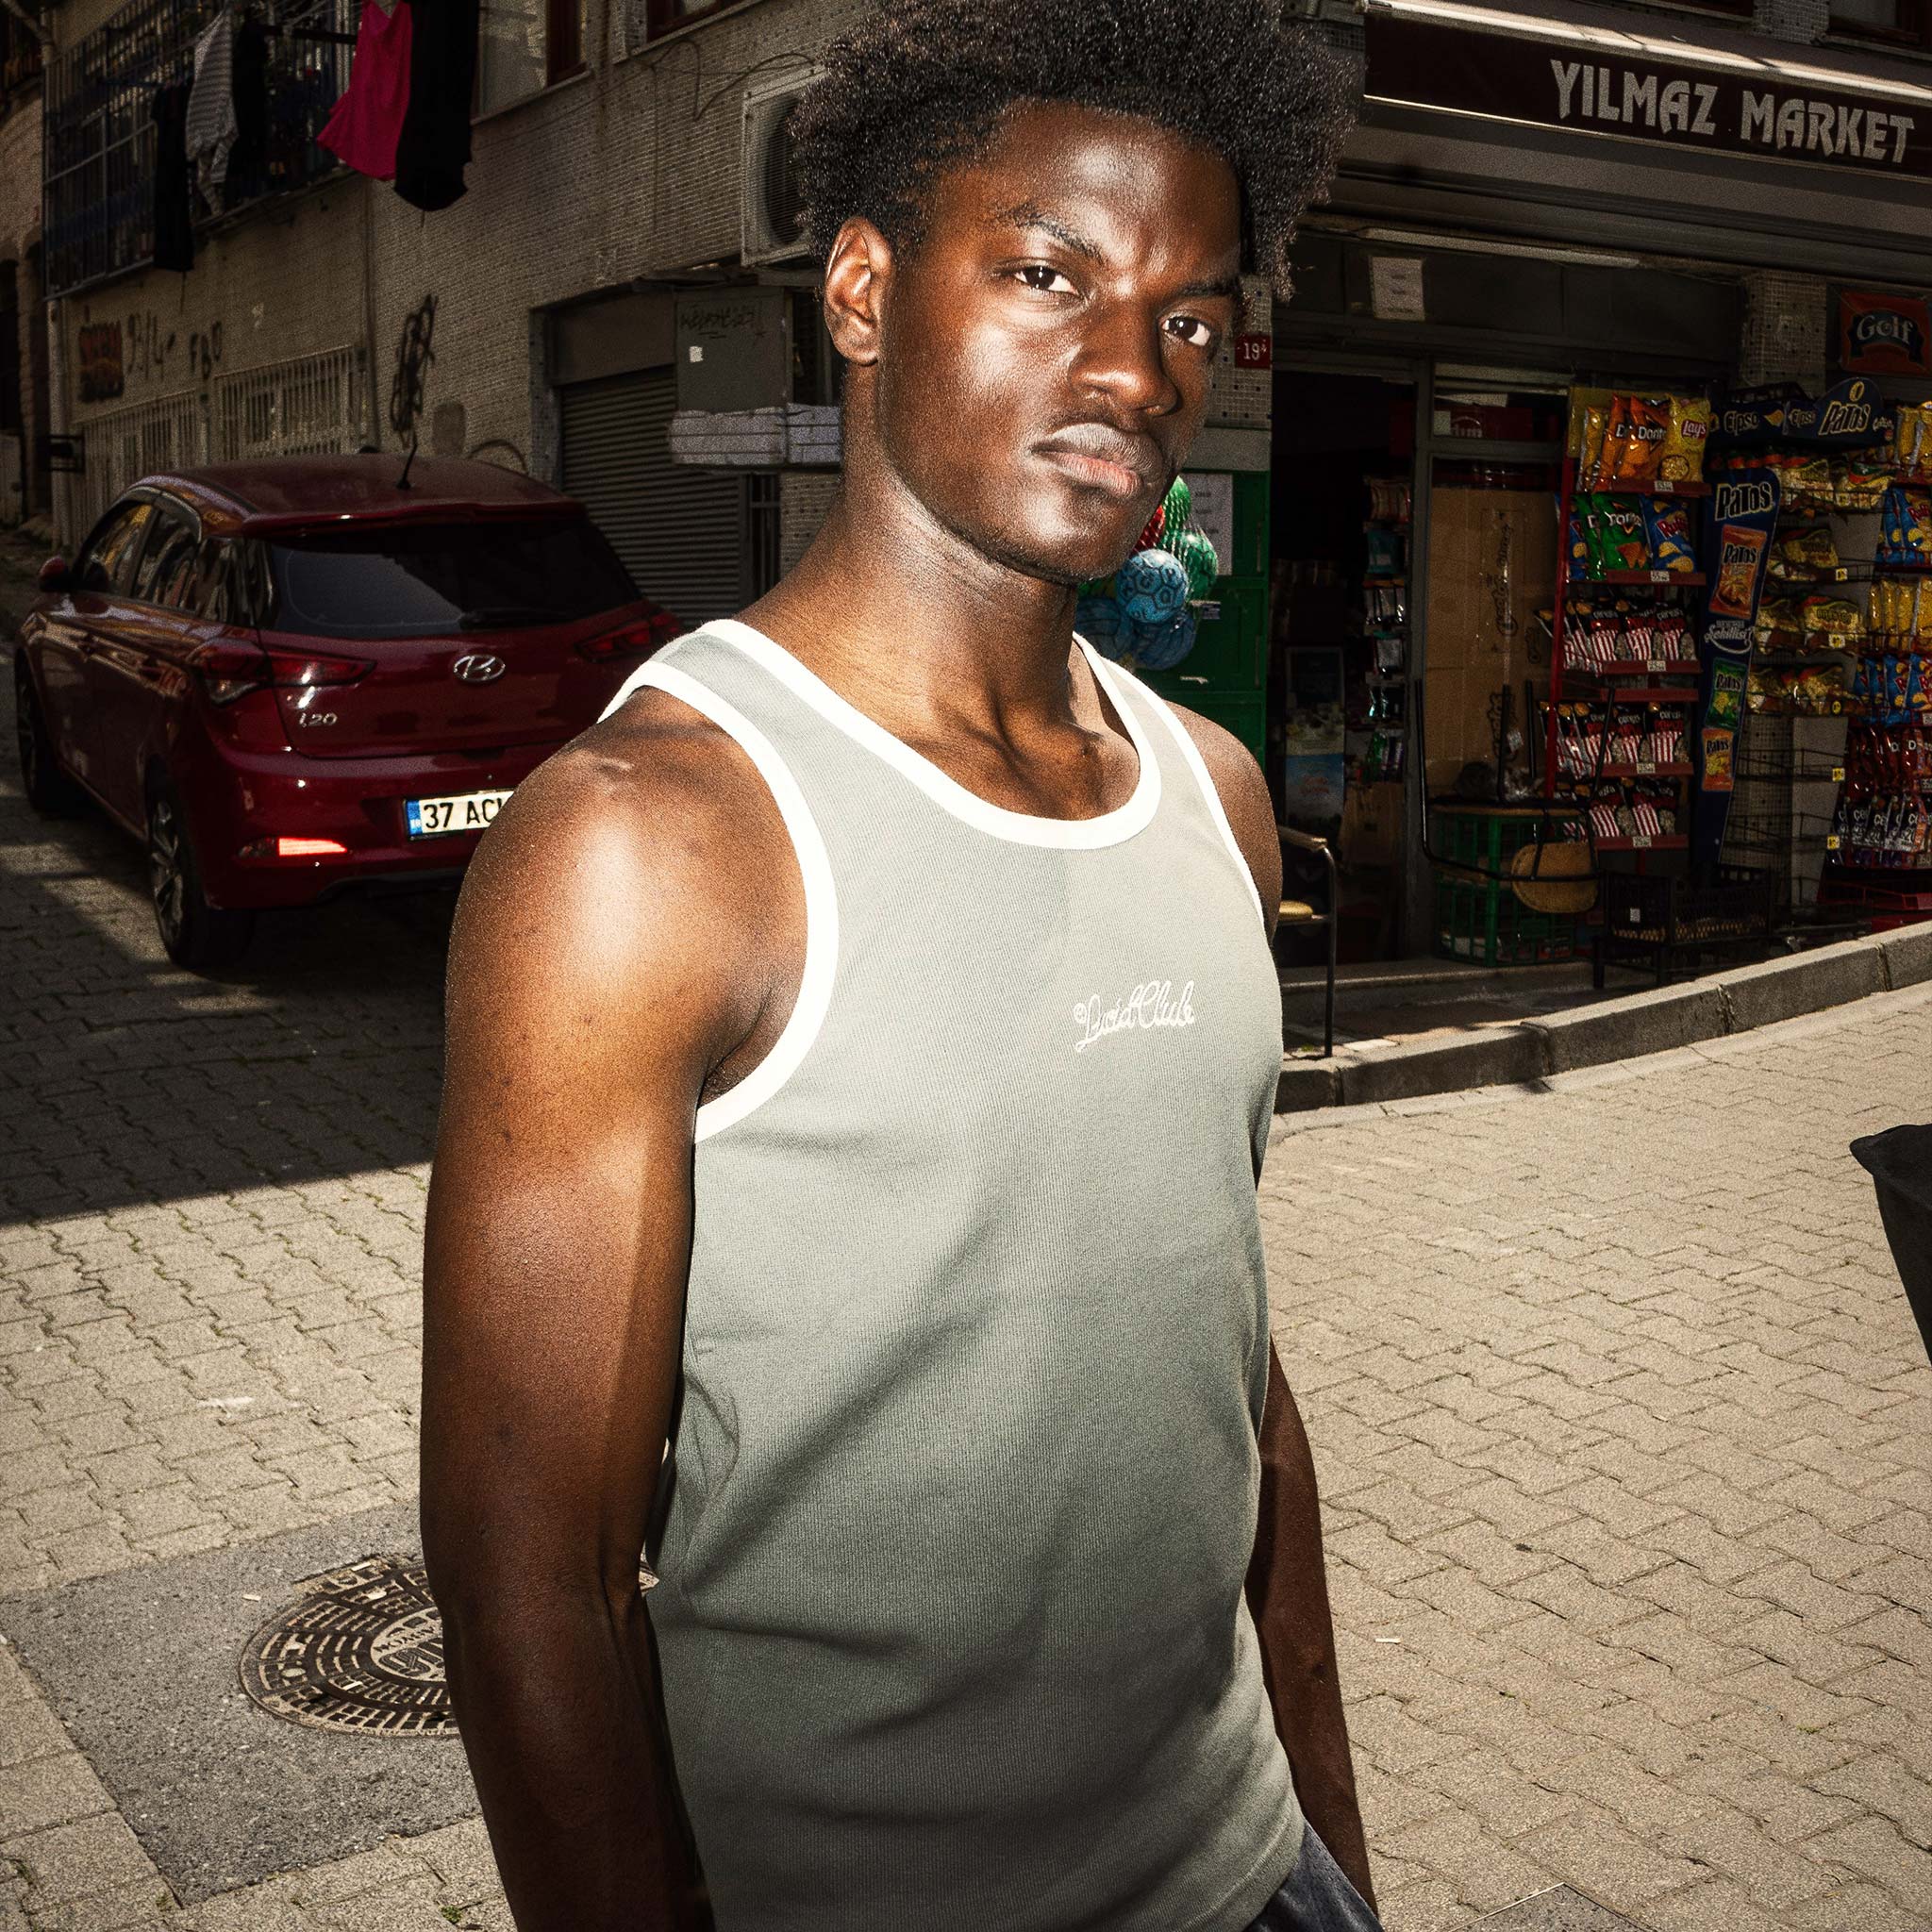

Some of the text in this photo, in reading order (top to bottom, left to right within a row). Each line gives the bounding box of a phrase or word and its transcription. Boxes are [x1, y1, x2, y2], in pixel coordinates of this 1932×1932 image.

[1550, 58, 1916, 164] YILMAZ MARKET
[1856, 314, 1914, 346] Golf
[1714, 480, 1775, 522] Patos
[424, 797, 502, 828] 37 AC
[1138, 979, 1195, 1029] Club
